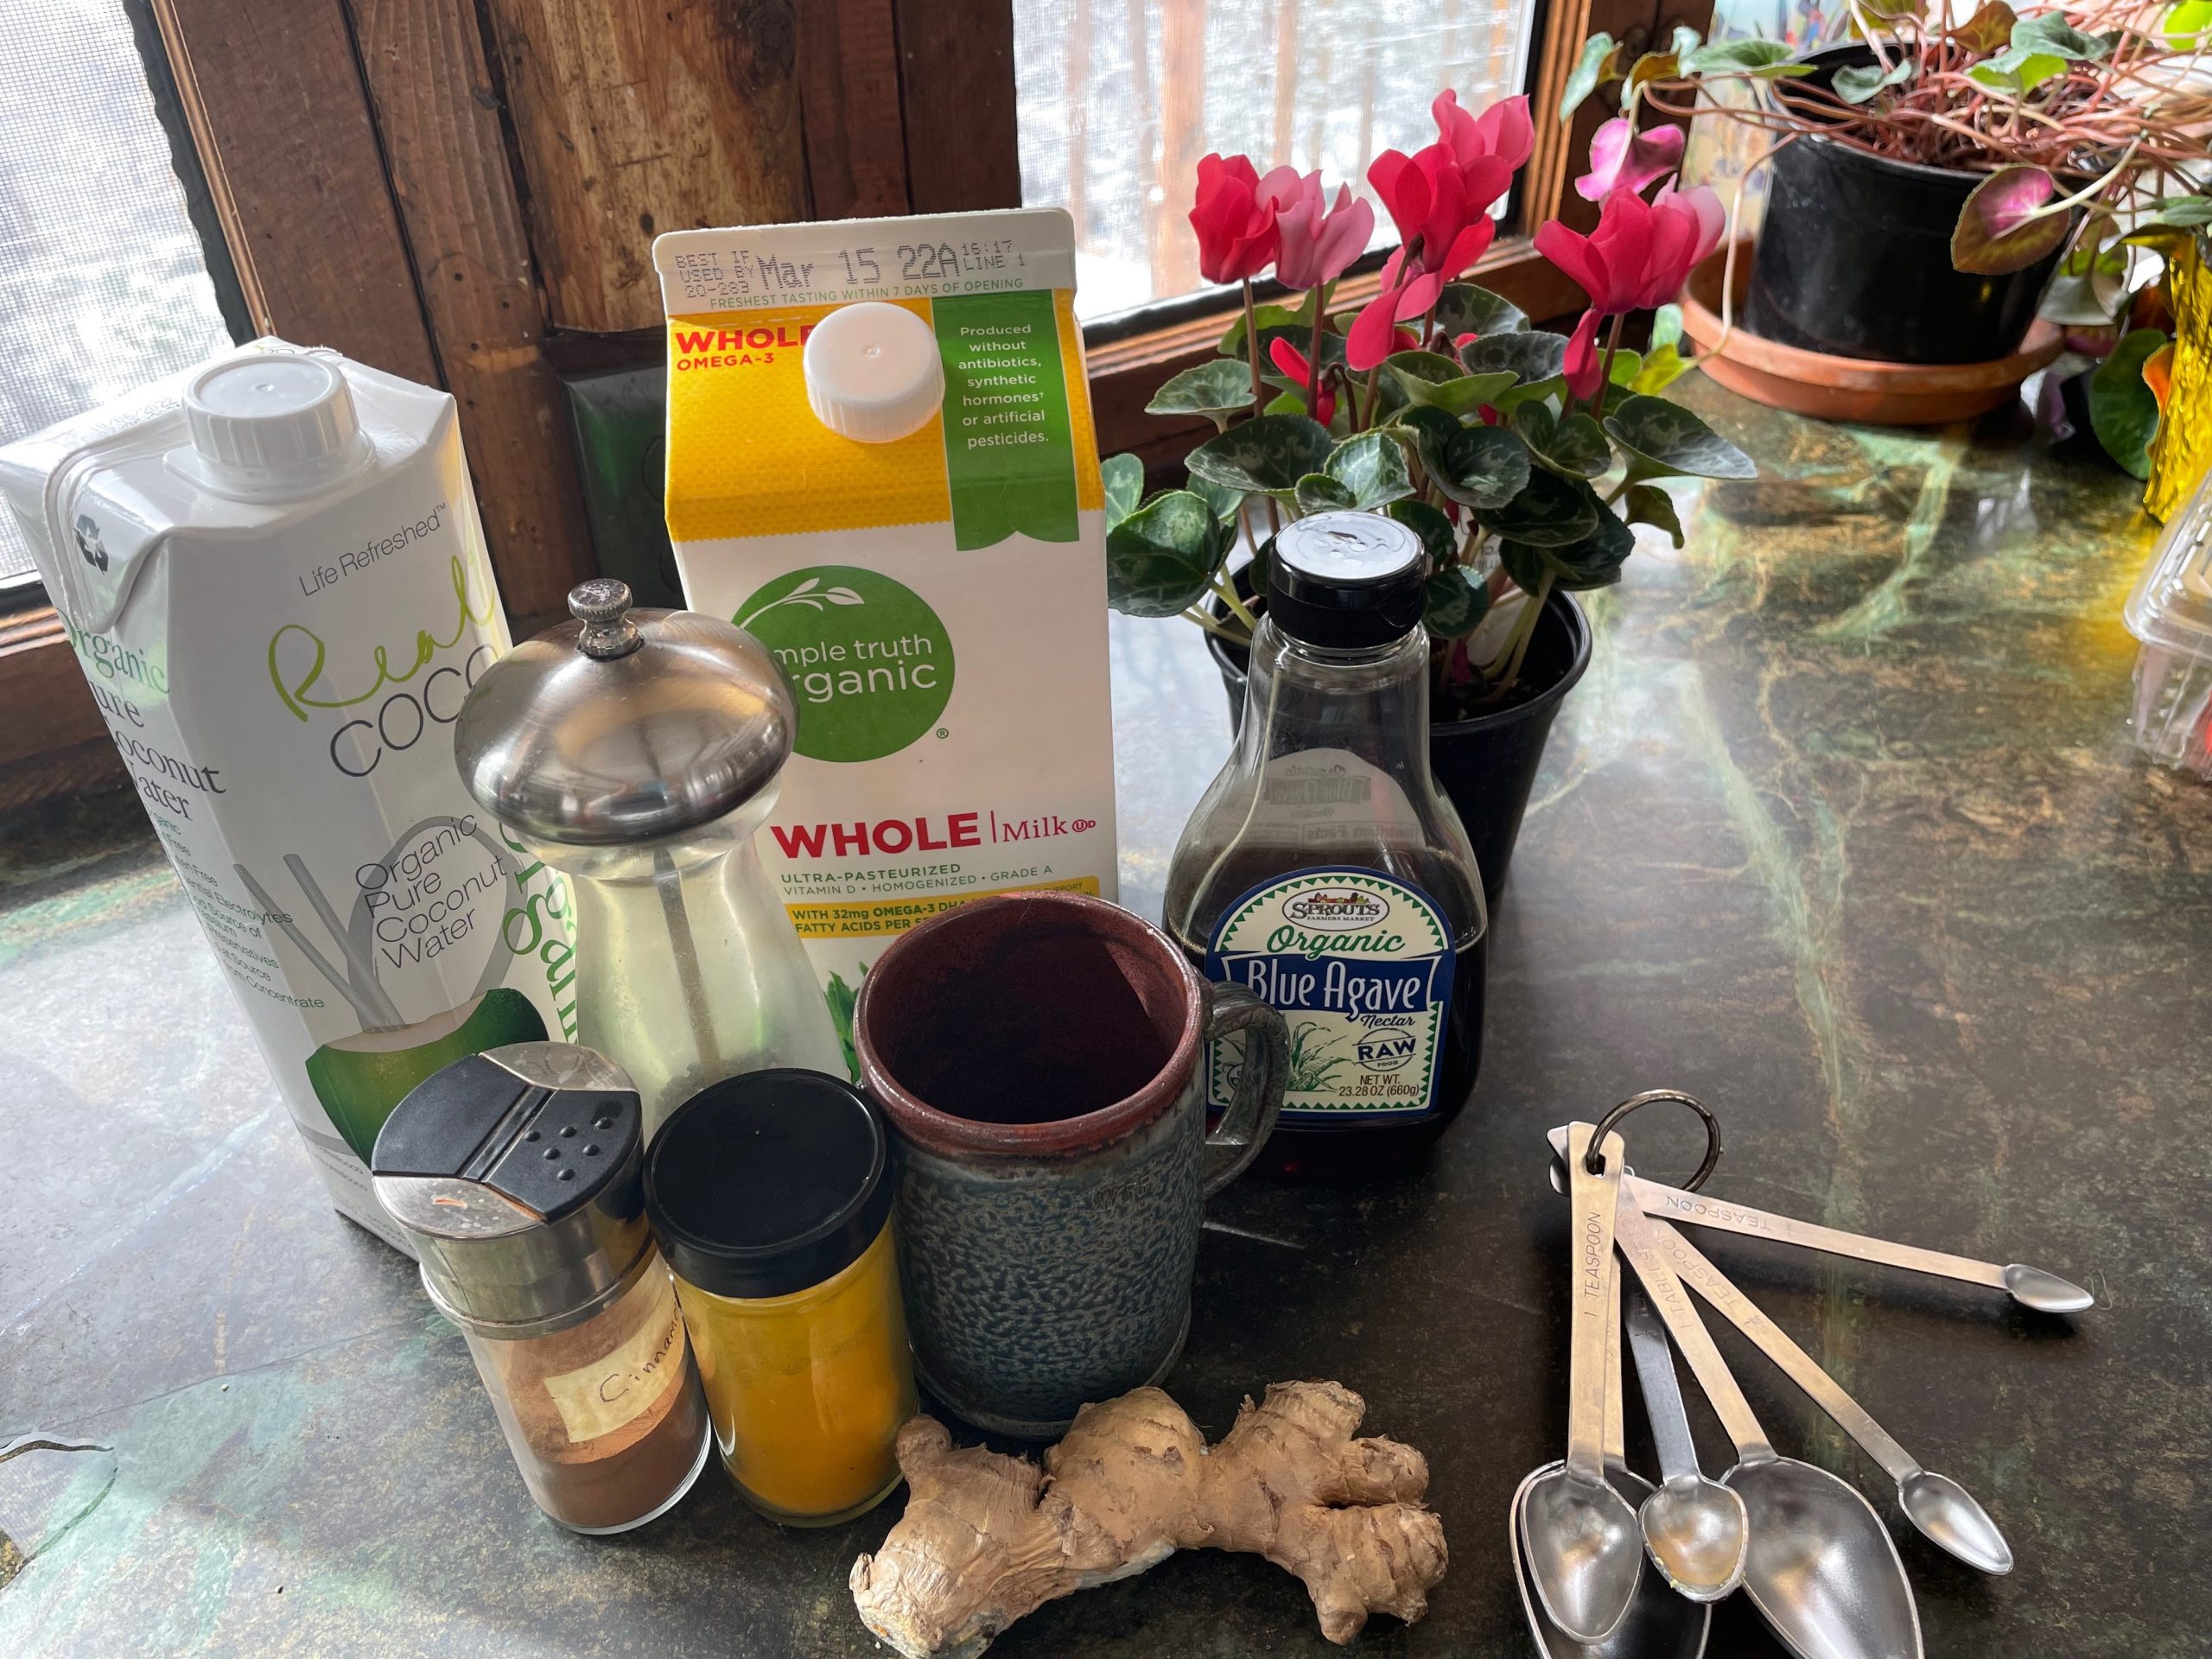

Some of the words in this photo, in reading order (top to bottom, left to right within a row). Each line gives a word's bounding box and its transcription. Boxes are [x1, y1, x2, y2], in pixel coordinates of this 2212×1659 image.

[676, 252, 717, 269] BEST
[732, 250, 750, 264] IF
[679, 267, 724, 283] USED
[734, 264, 753, 279] BY
[755, 253, 814, 290] Mar
[837, 247, 881, 285] 15
[897, 243, 961, 281] 22A
[963, 256, 1006, 270] LINE
[709, 295, 777, 309] FRESHEST
[781, 290, 837, 304] TASTING
[842, 287, 889, 300] WITHIN
[893, 287, 900, 296] 7
[904, 282, 939, 296] DAYS
[942, 282, 961, 294] OF
[963, 277, 1024, 292] OPENING
[960, 324, 1032, 336] Produced
[677, 352, 774, 372] OMEGA-3
[969, 340, 1027, 353] without
[958, 357, 1042, 370] antibiotics,
[967, 373, 1037, 389] synthetic
[962, 416, 978, 427] or
[983, 410, 1046, 425] artificial
[967, 430, 1050, 450] pesticides.
[298, 566, 340, 598] Life
[268, 554, 496, 722] Real
[773, 640, 847, 668] mple
[853, 633, 933, 660] truth
[791, 659, 938, 704] ganic
[89, 680, 144, 728] ure
[112, 728, 226, 794] oconut
[769, 811, 982, 860] WHOLE
[1001, 816, 1069, 842] Milk
[355, 814, 478, 891] Organic
[780, 863, 961, 884] ULTRA-PASTEURIZED
[784, 885, 842, 896] VITAMIN
[847, 885, 856, 894] D
[872, 874, 977, 893] HOMOGENIZED
[990, 867, 1038, 881] GRADE
[1043, 865, 1053, 874] A
[1043, 882, 1083, 892] UPPORT
[214, 891, 294, 925] Electrolytes
[364, 871, 442, 919] Pure
[376, 855, 508, 944] Coconut
[1288, 901, 1381, 919] SPROUTS
[792, 910, 830, 921] WITH
[833, 908, 869, 921] 32mg
[873, 903, 935, 918] OMEGA-3
[795, 923, 836, 933] FATTY
[841, 920, 881, 931] ACIDS
[885, 918, 911, 930] PER
[381, 907, 476, 969] Water
[1266, 925, 1407, 960] Organic
[245, 976, 326, 1008] Concentrate
[1248, 958, 1316, 1008] Blue
[1323, 960, 1421, 1023] Agave
[1360, 1014, 1416, 1029] Nectar
[1357, 1038, 1416, 1061] RAW
[1377, 1059, 1399, 1068] FOOD
[1338, 1085, 1369, 1097] 23.28
[1370, 1085, 1385, 1097] OZ
[1386, 1084, 1420, 1098] (660g)
[1359, 1074, 1382, 1086] NET
[1382, 1073, 1401, 1085] WT.
[1666, 1195, 1775, 1231] TEASPOON
[1584, 1211, 1601, 1298] TEASPOON
[599, 1300, 678, 1403] Cinnam
